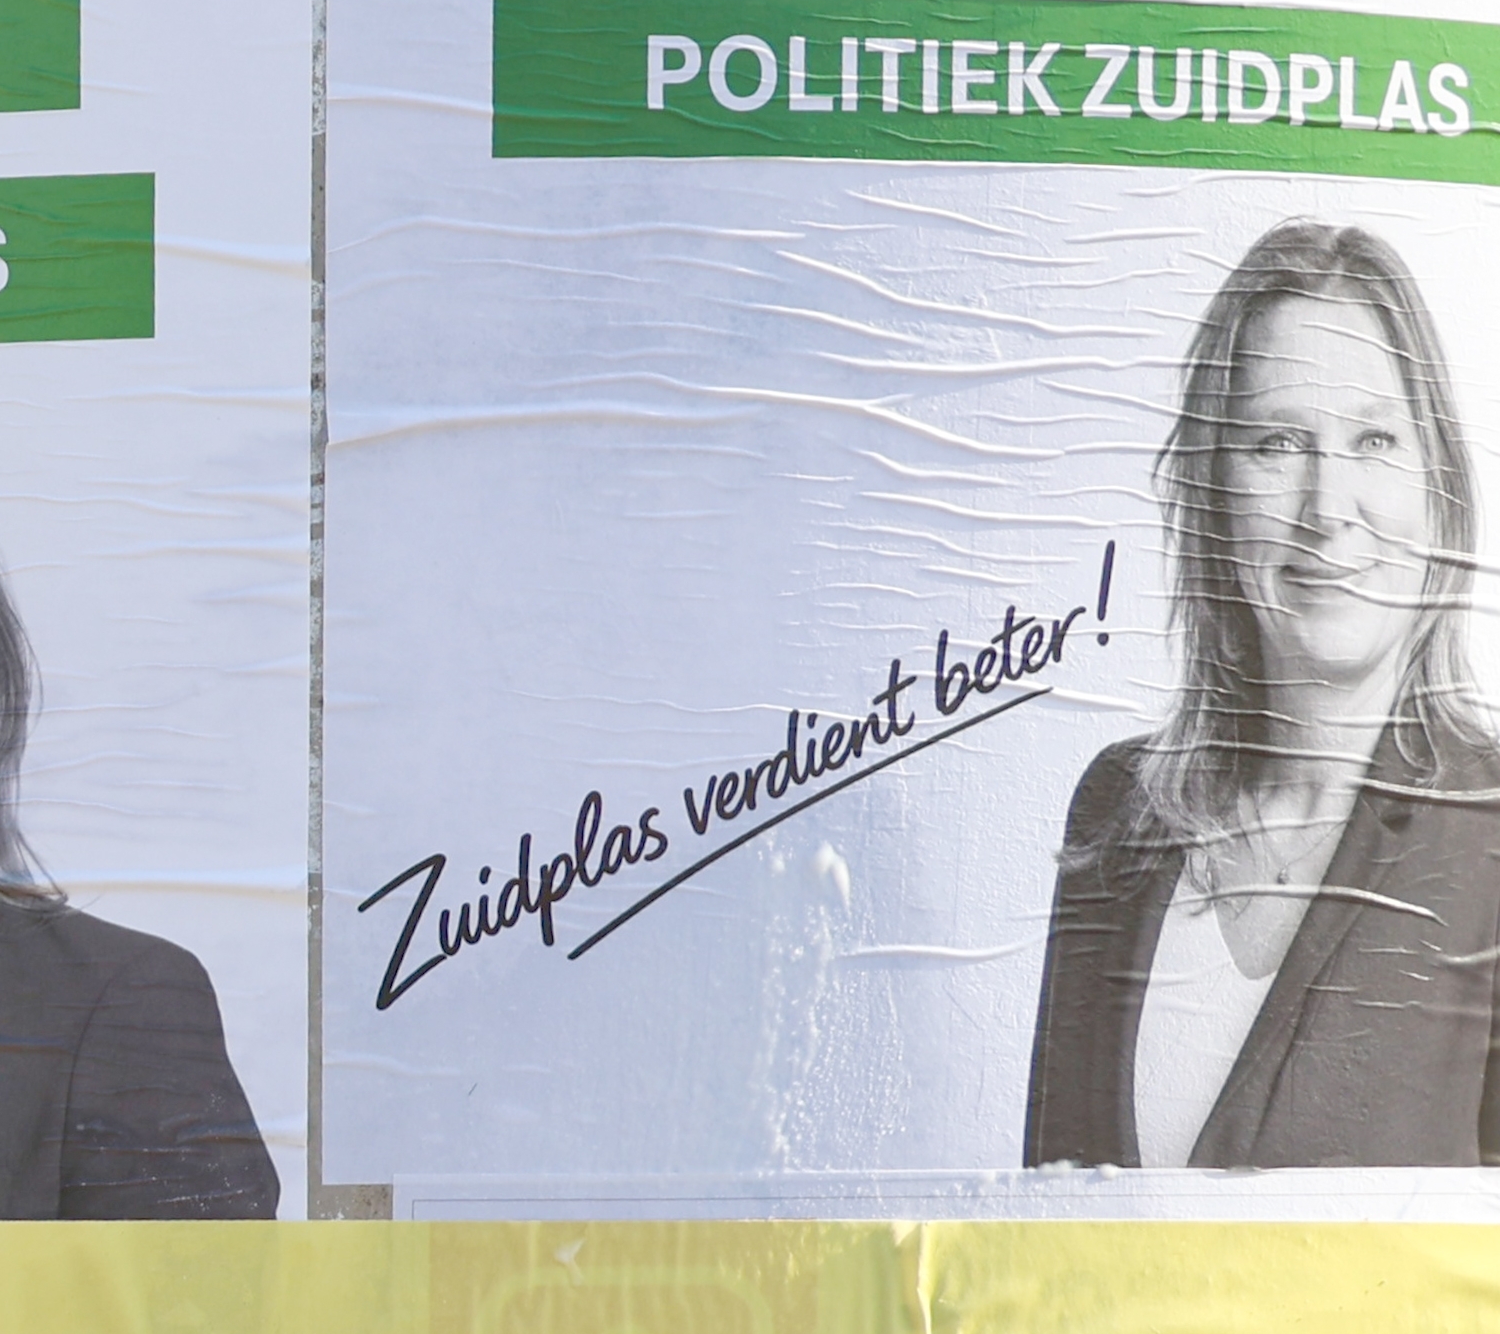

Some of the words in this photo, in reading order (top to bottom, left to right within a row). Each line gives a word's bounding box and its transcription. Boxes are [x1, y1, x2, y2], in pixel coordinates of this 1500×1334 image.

[646, 33, 1062, 117] POLITIEK
[1081, 43, 1471, 137] ZUIDPLAS
[357, 790, 669, 1011] Zuidplas
[683, 657, 918, 835] verdient
[934, 539, 1116, 717] beter!
